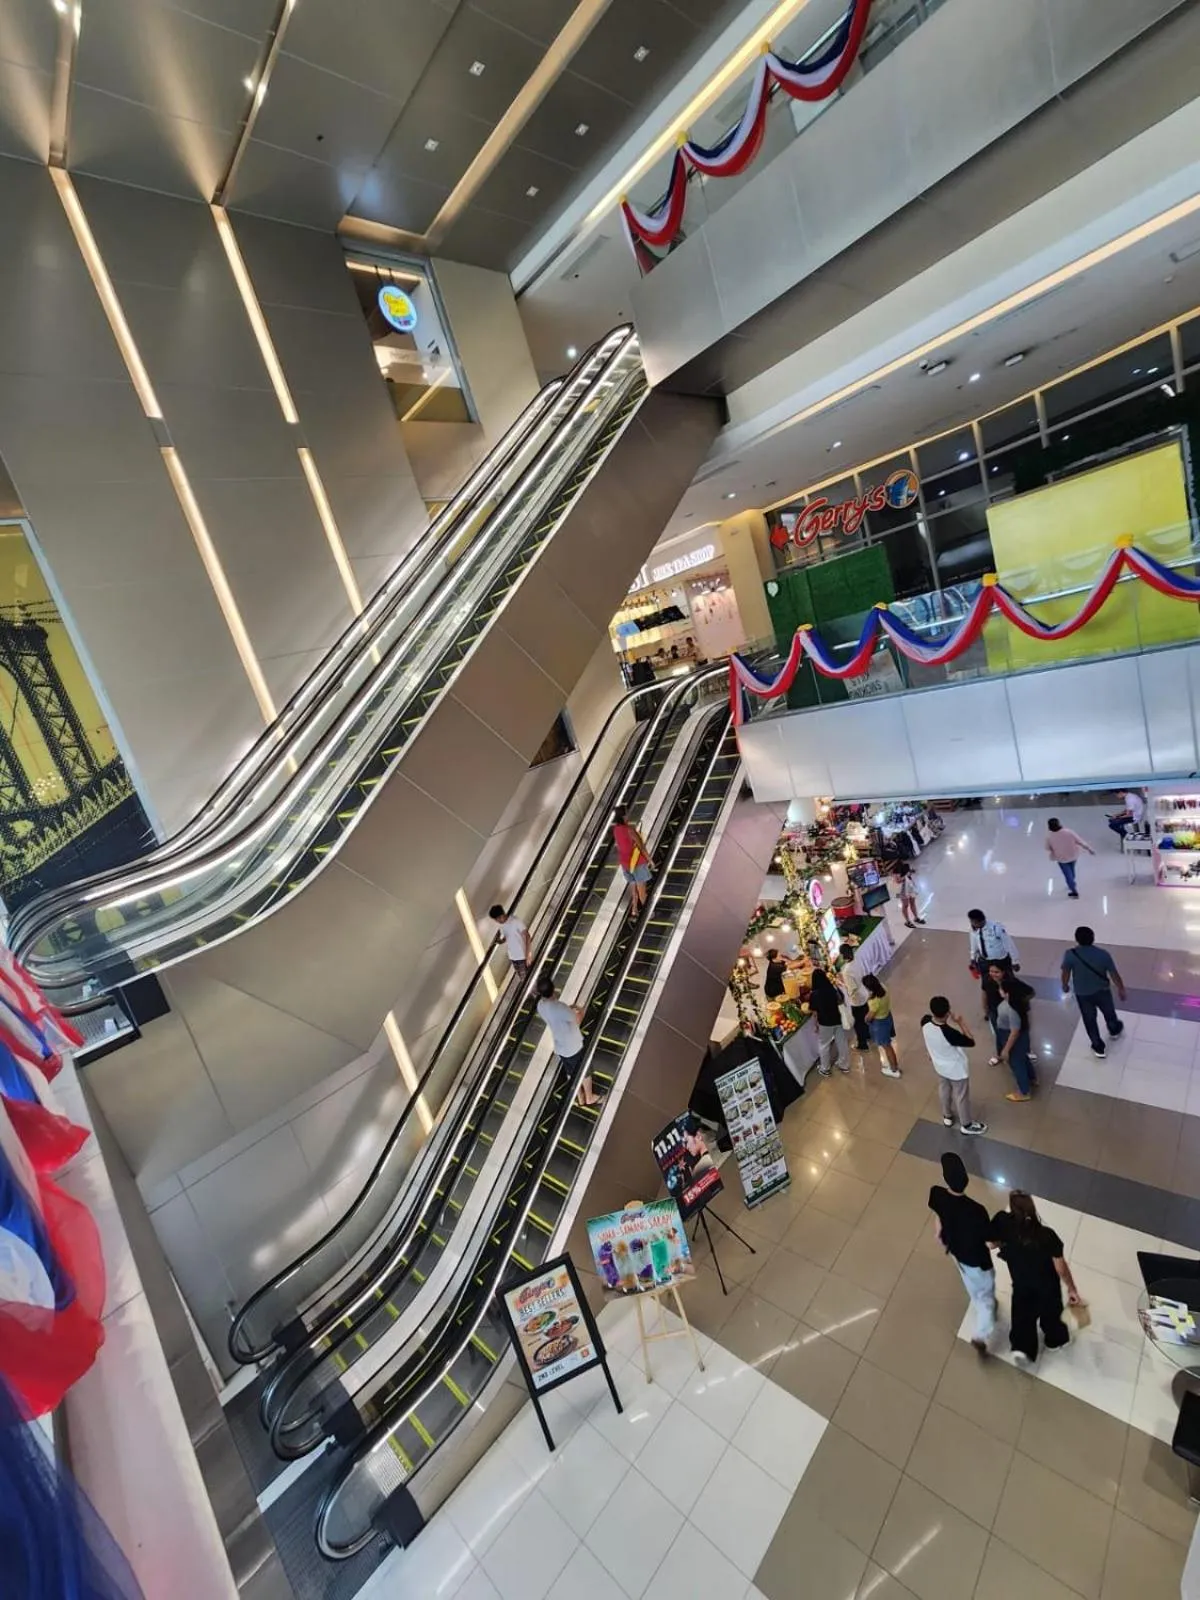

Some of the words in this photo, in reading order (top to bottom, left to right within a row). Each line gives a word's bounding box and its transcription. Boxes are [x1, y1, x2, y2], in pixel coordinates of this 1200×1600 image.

[794, 484, 886, 548] Gerry's
[654, 1127, 681, 1159] 11.11
[537, 1288, 567, 1308] SELLERS
